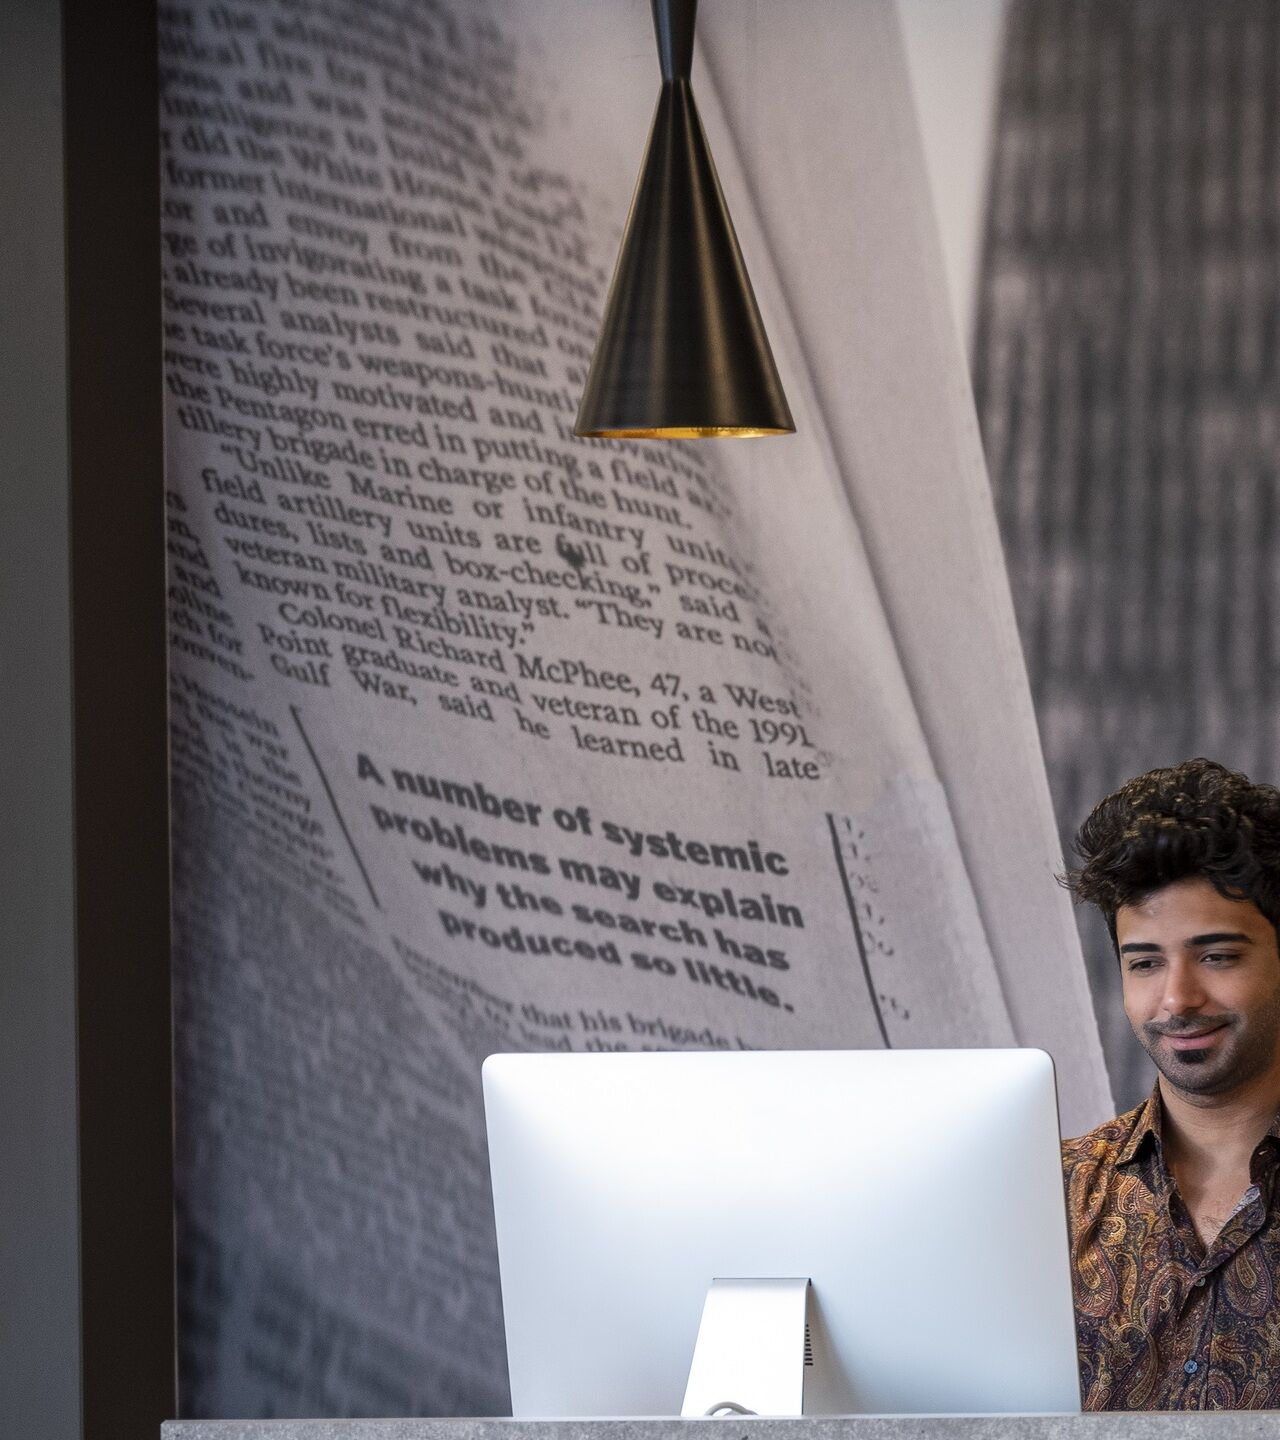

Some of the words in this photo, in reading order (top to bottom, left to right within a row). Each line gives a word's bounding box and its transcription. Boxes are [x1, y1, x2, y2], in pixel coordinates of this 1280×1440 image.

[166, 157, 266, 195] former
[213, 202, 269, 230] and
[173, 260, 279, 303] already
[284, 270, 360, 308] been
[243, 236, 429, 296] invigorating
[279, 309, 401, 347] analysts
[227, 356, 320, 403] highly
[331, 380, 478, 424] motivated
[356, 352, 582, 416] weapons-hunti
[214, 384, 348, 433] Pentagon
[352, 414, 430, 449] erred
[433, 423, 468, 454] in
[471, 434, 583, 479] putting
[587, 461, 604, 482] a
[609, 458, 680, 499] field
[264, 425, 378, 470] brigade
[378, 447, 412, 480] in
[417, 456, 518, 495] charge
[523, 470, 554, 496] of
[558, 476, 609, 510] the
[610, 488, 693, 531] hunt.
[200, 466, 267, 505] field
[275, 490, 393, 538] artillery
[405, 518, 482, 550] units
[494, 531, 543, 554] are
[620, 552, 652, 577] of
[213, 500, 300, 544] dures,
[305, 518, 368, 556] lists
[378, 542, 434, 572] and
[677, 593, 742, 625] said
[345, 468, 455, 516] Marine
[472, 500, 505, 521] or
[522, 496, 646, 551] infantry
[222, 533, 329, 575] veteran
[331, 557, 447, 606] military
[455, 585, 571, 620] analyst.
[674, 620, 725, 646] are
[232, 558, 334, 602] known
[334, 580, 375, 613] for
[256, 620, 335, 659] Point
[340, 642, 460, 688] graduate
[469, 673, 524, 705] and
[530, 689, 643, 729] veteran
[650, 703, 683, 730] of
[691, 707, 742, 741] the
[748, 716, 818, 750] 1991
[276, 600, 389, 644] Colonel
[391, 622, 509, 675] Richard
[513, 650, 642, 700] McPhee,
[649, 671, 691, 703] 47,
[698, 683, 718, 705] a
[722, 681, 804, 720] West
[269, 651, 332, 689] Gulf
[350, 668, 419, 708] War,
[437, 691, 496, 724] said
[512, 706, 552, 741] he
[570, 723, 687, 764] learned
[706, 738, 744, 774] in
[760, 750, 823, 782] late
[356, 751, 386, 787] A
[390, 766, 543, 828] number
[552, 804, 593, 836] of
[600, 819, 791, 877] systemic
[368, 801, 552, 876] problems
[557, 855, 643, 901] may
[651, 880, 806, 930] explain
[410, 858, 489, 910] why
[495, 880, 564, 917] the
[570, 902, 709, 949] search
[712, 926, 792, 972] has
[436, 907, 624, 967] produced
[629, 950, 679, 978] so
[681, 954, 796, 1014] little.
[578, 1008, 624, 1034] his
